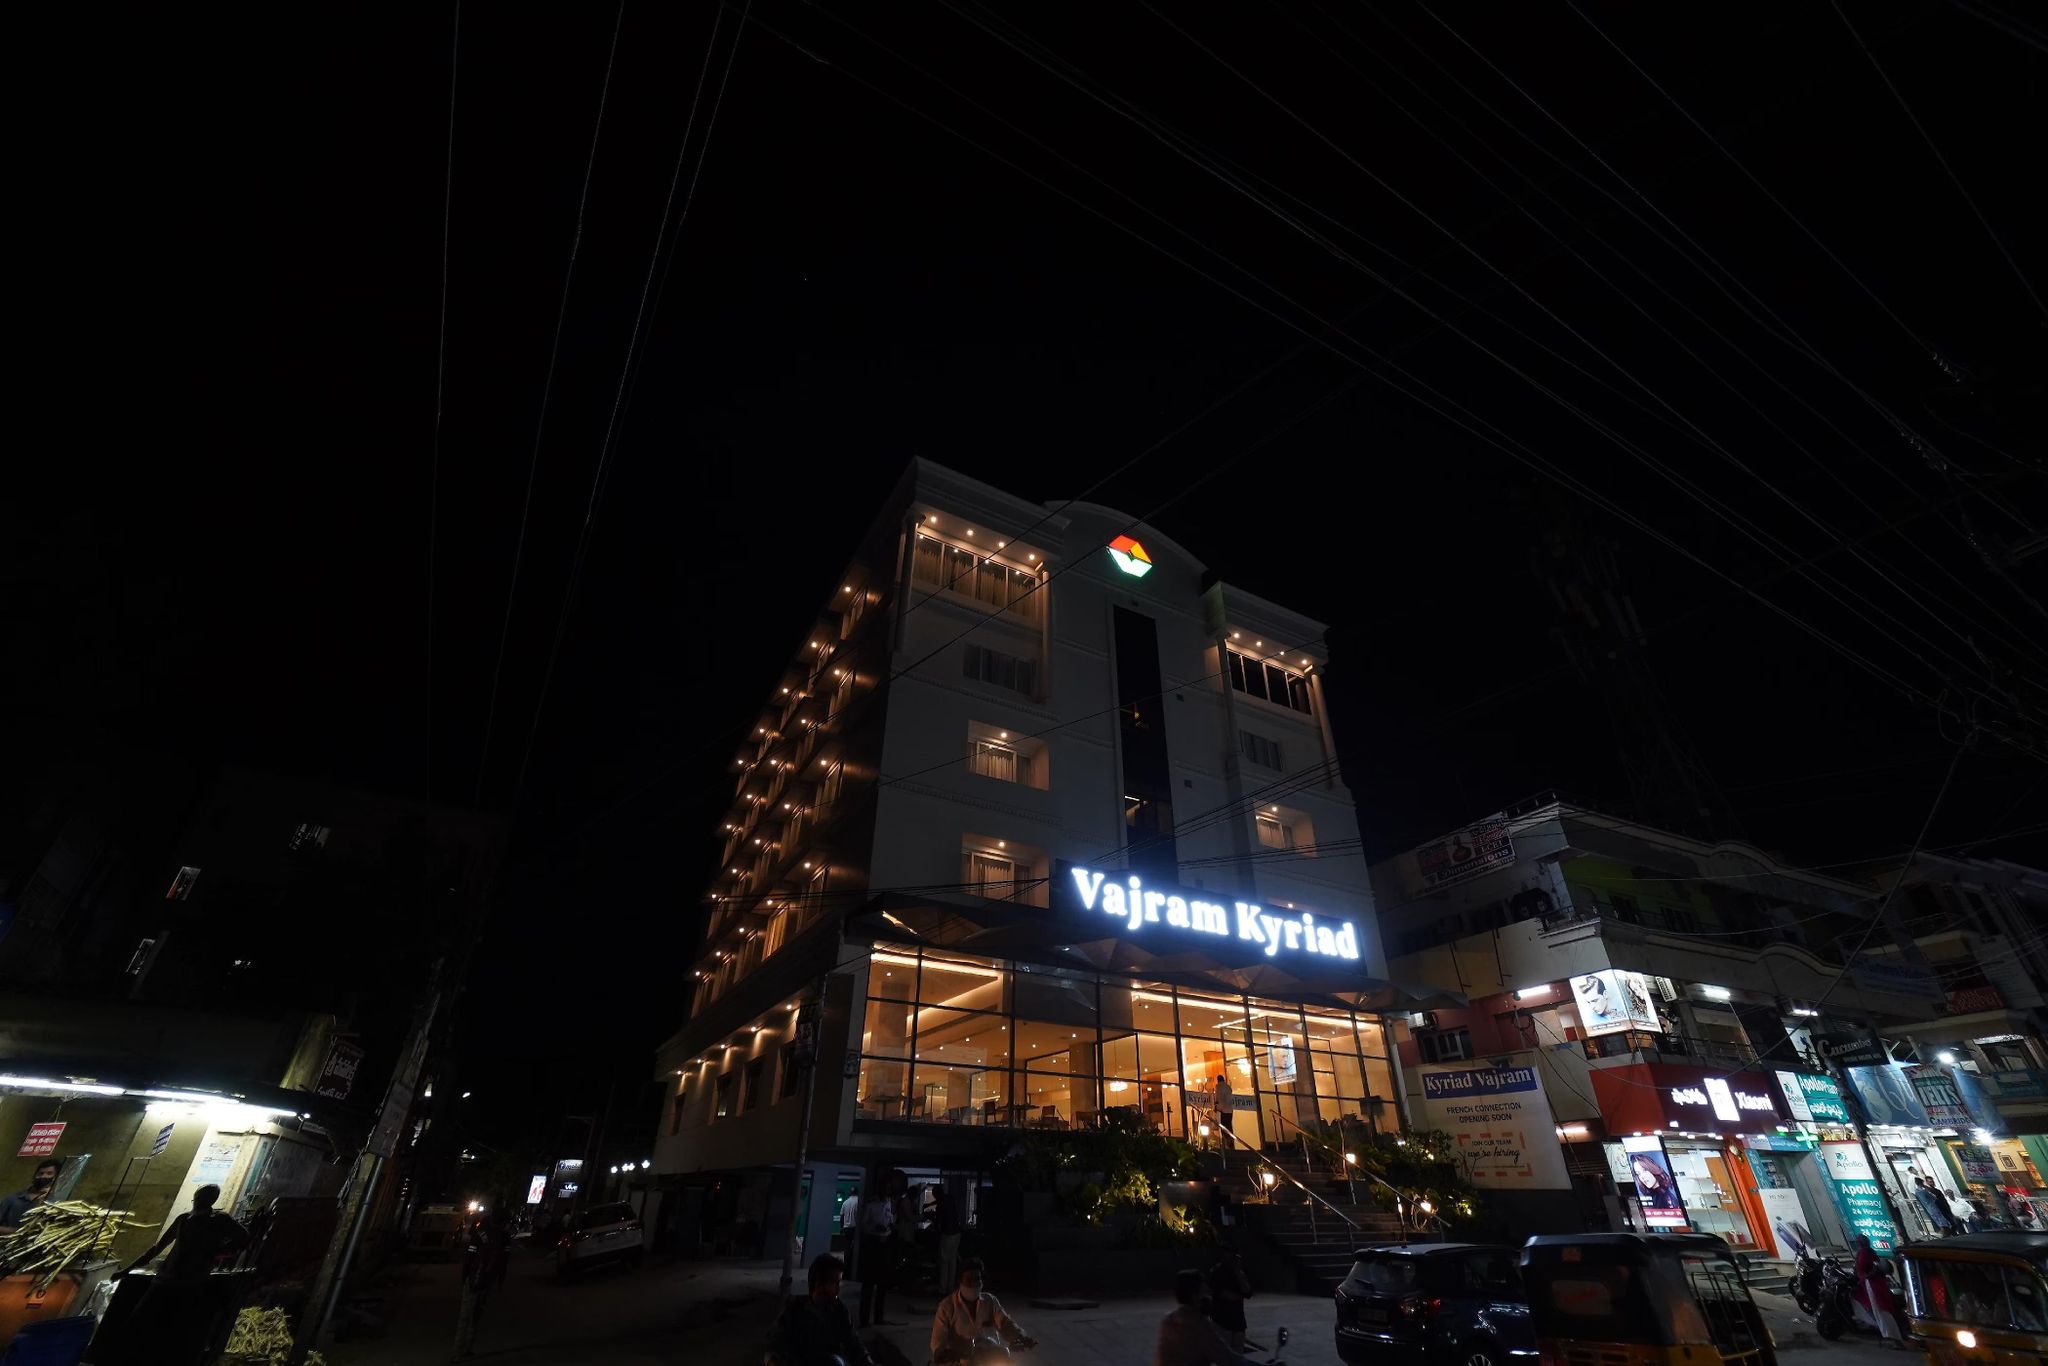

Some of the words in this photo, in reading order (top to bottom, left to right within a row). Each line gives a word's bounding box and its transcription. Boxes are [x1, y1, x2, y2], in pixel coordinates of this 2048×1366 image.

[1071, 867, 1229, 935] Vajram
[1235, 902, 1359, 960] Kyriad
[1425, 1072, 1473, 1095] Kyriad
[1475, 1069, 1532, 1090] Vajram
[1917, 1085, 1962, 1107] IELTS
[1446, 1106, 1474, 1115] FRENCH
[1474, 1102, 1522, 1113] CONNECTION
[1459, 1114, 1490, 1123] OPENING
[1491, 1113, 1513, 1121] SOON
[1493, 1146, 1521, 1166] hiring
[1841, 1182, 1879, 1197] Apollo
[1847, 1197, 1882, 1208] Pharmacy
